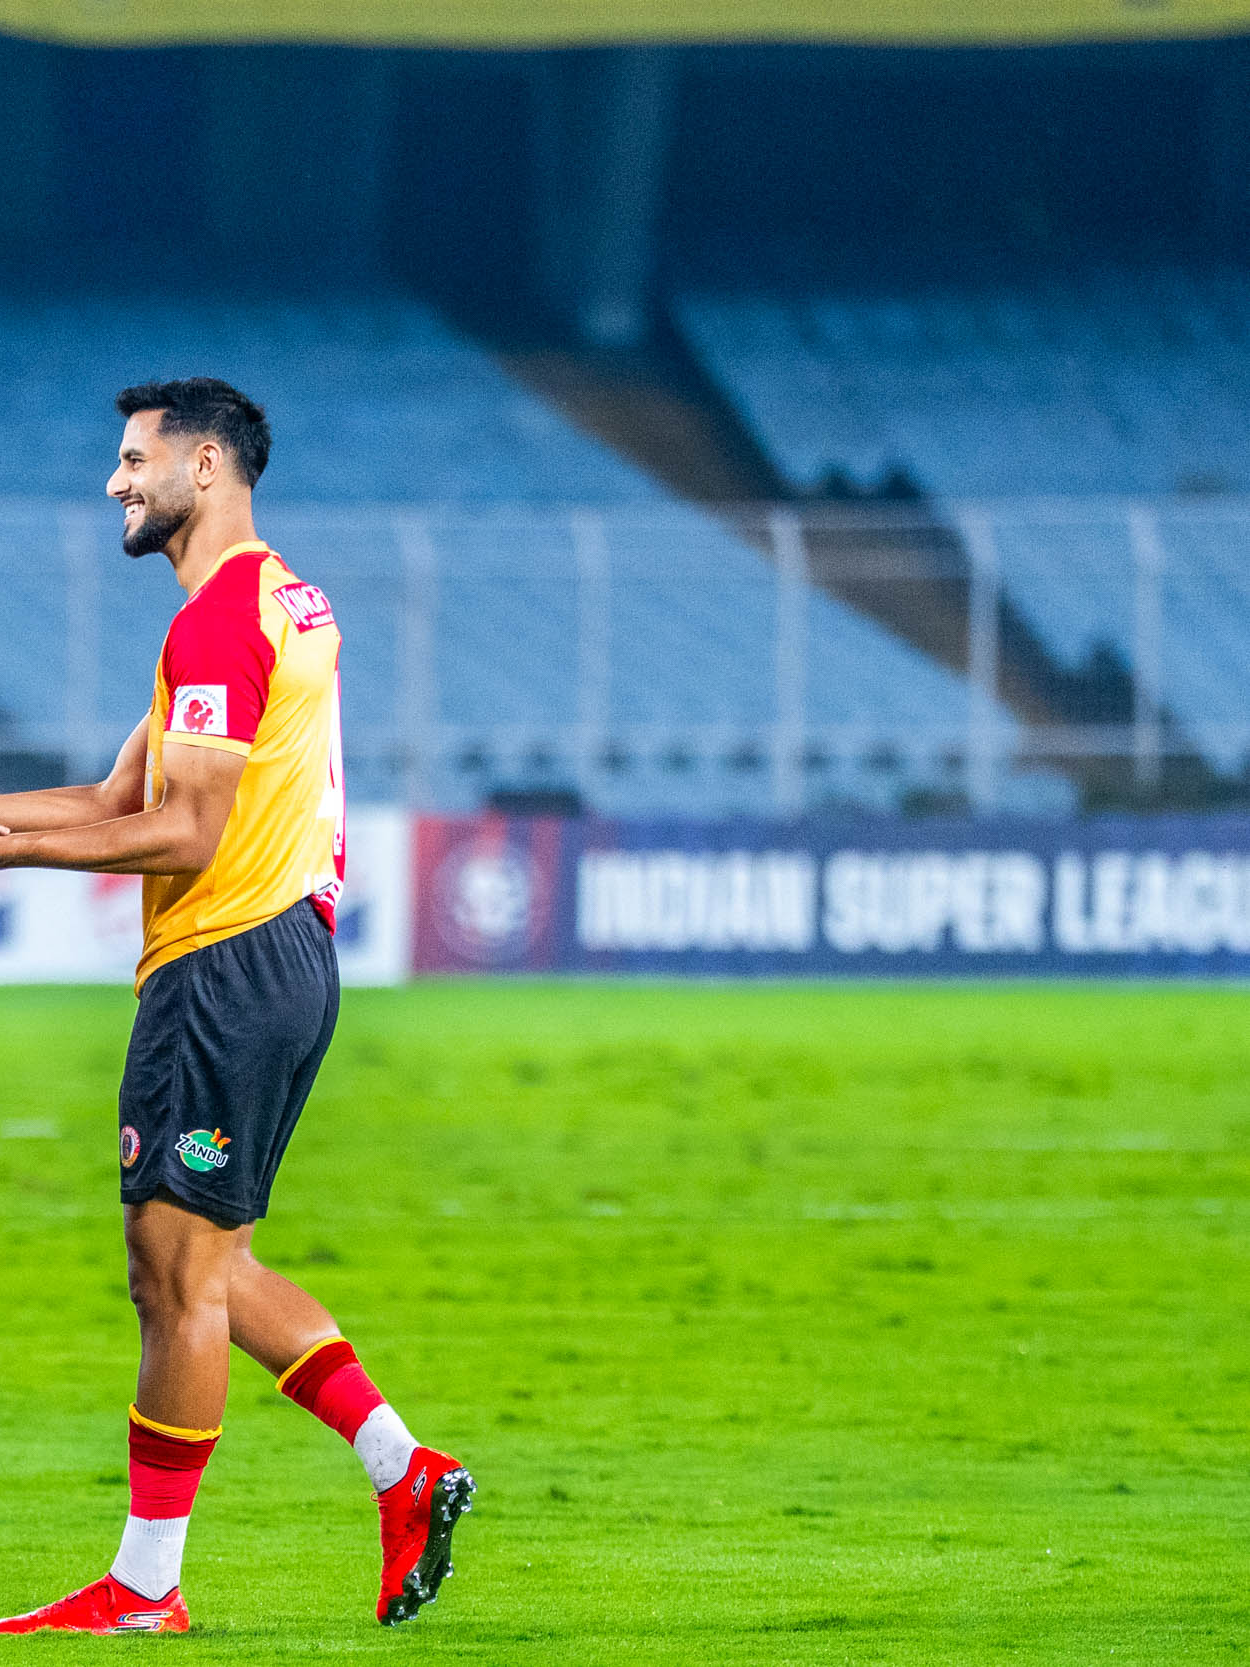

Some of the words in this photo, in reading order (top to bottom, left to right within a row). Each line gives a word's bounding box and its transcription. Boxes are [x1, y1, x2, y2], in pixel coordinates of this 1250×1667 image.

[577, 850, 816, 953] INDIAN
[823, 850, 1047, 953] SUPER
[175, 1133, 229, 1168] ZANDU
